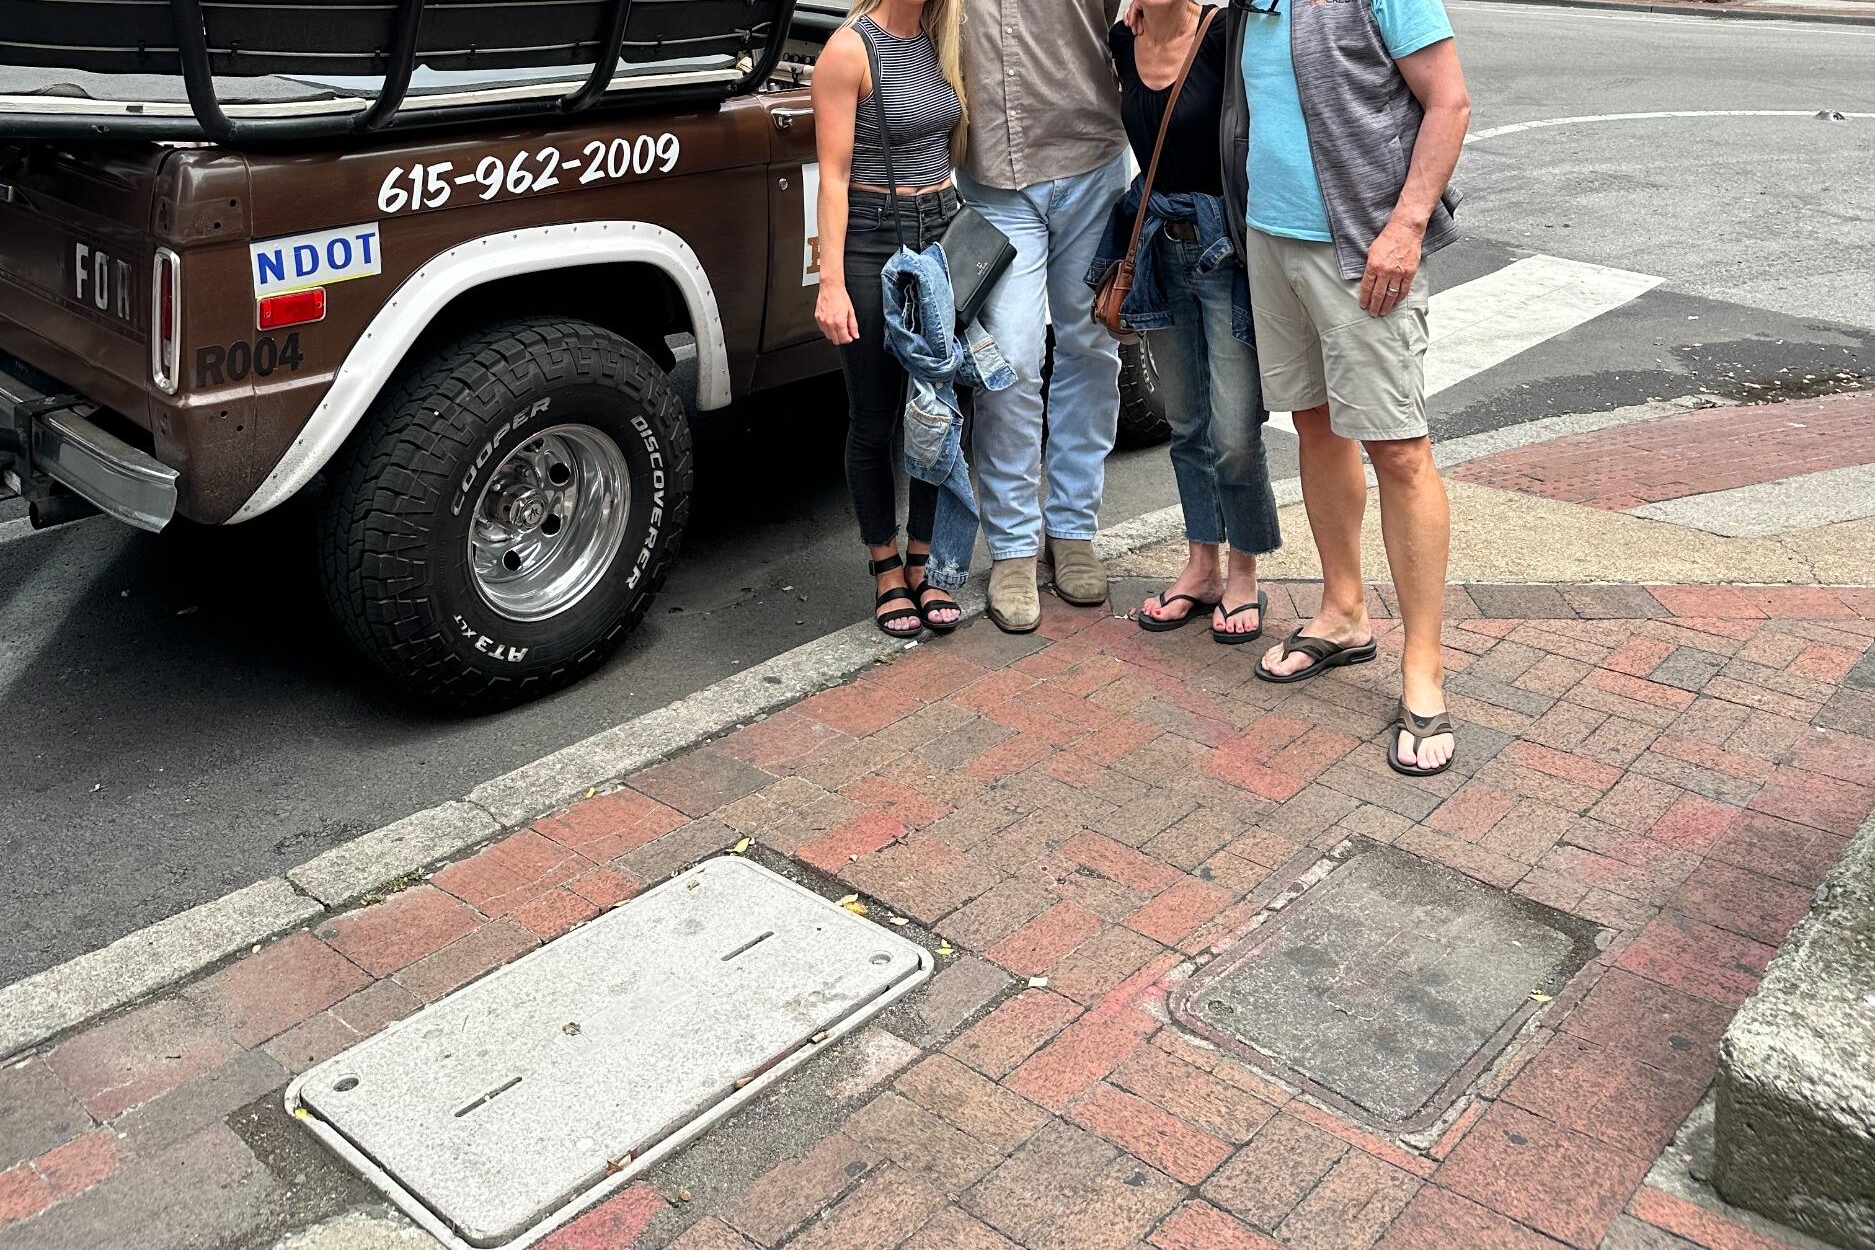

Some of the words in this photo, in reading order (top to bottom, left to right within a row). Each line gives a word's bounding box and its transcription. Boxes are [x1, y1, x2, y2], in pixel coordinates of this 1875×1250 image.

[377, 132, 681, 214] 615-962-2009
[256, 232, 376, 285] NDOT
[195, 332, 304, 389] R004
[450, 396, 551, 517] COOPER
[625, 414, 666, 590] DISCOVERER
[453, 614, 478, 638] XLT
[474, 635, 529, 663] AT3
